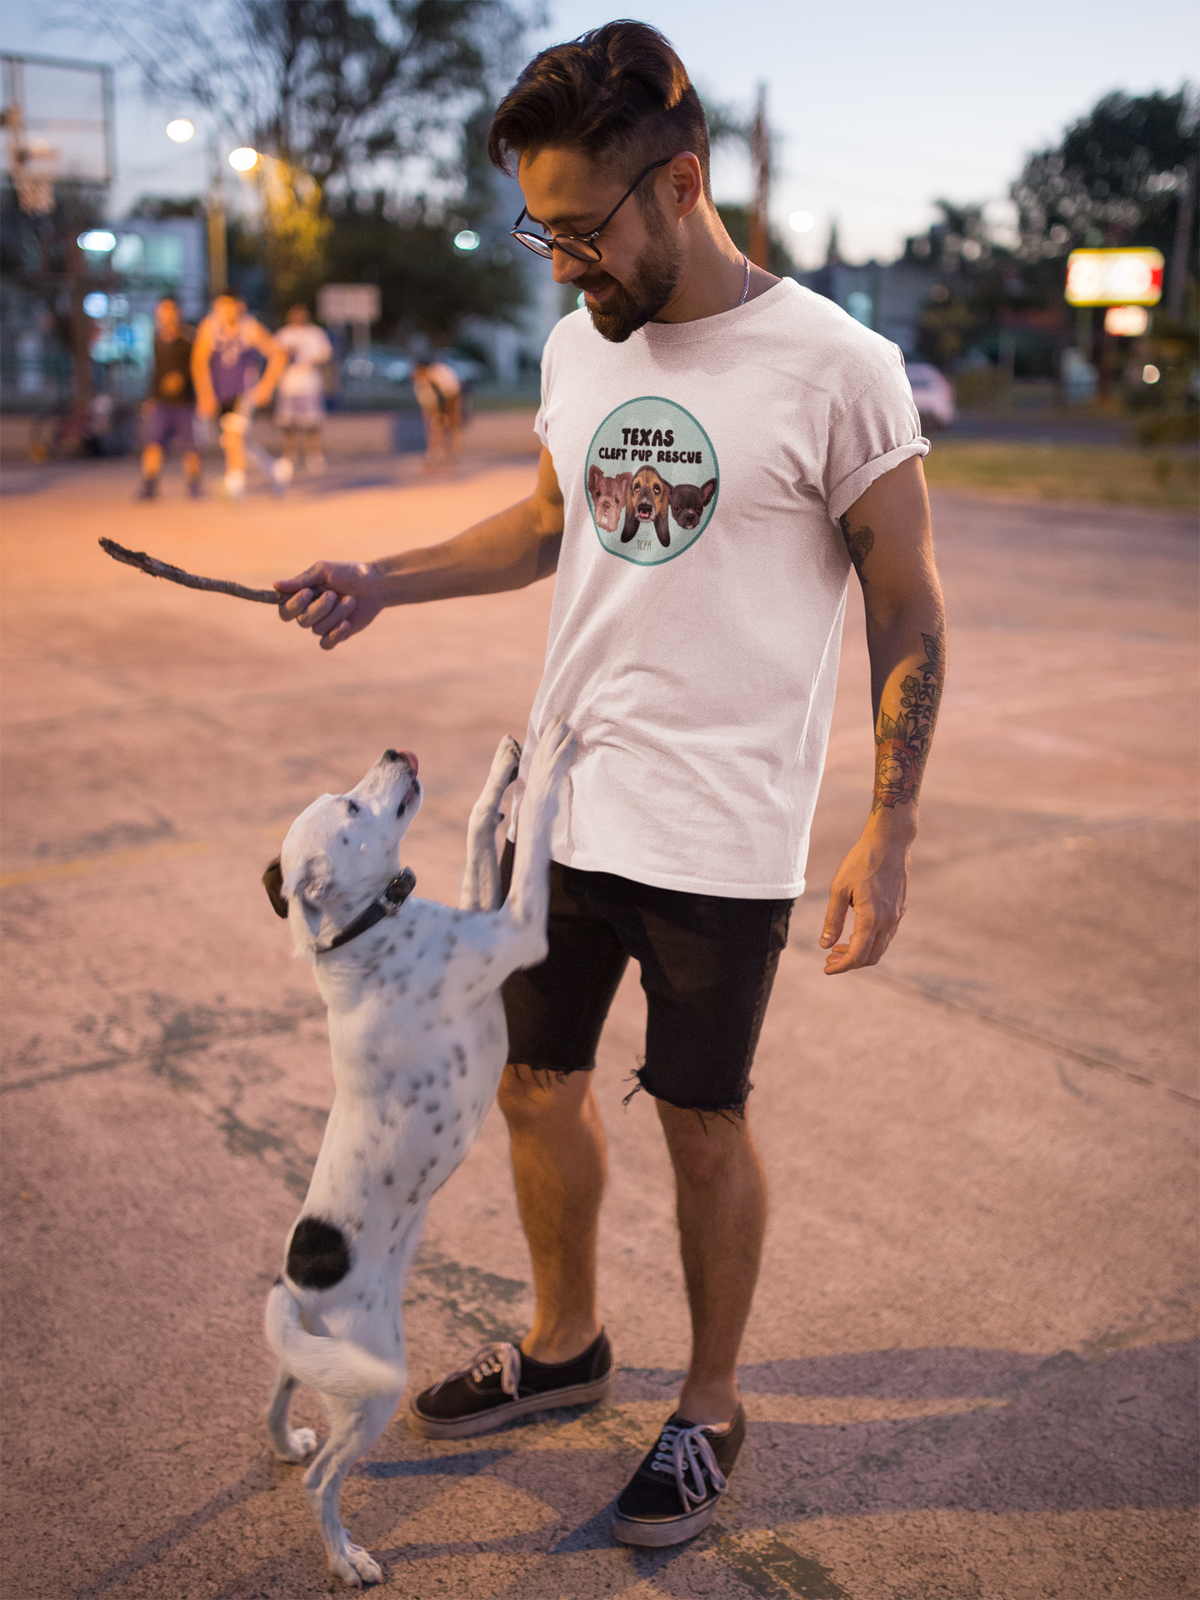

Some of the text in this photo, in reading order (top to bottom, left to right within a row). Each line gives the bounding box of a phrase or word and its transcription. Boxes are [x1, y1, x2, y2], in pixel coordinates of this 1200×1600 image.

[622, 428, 674, 447] TEXAS
[598, 447, 702, 464] CLEFT PUP RESCUE
